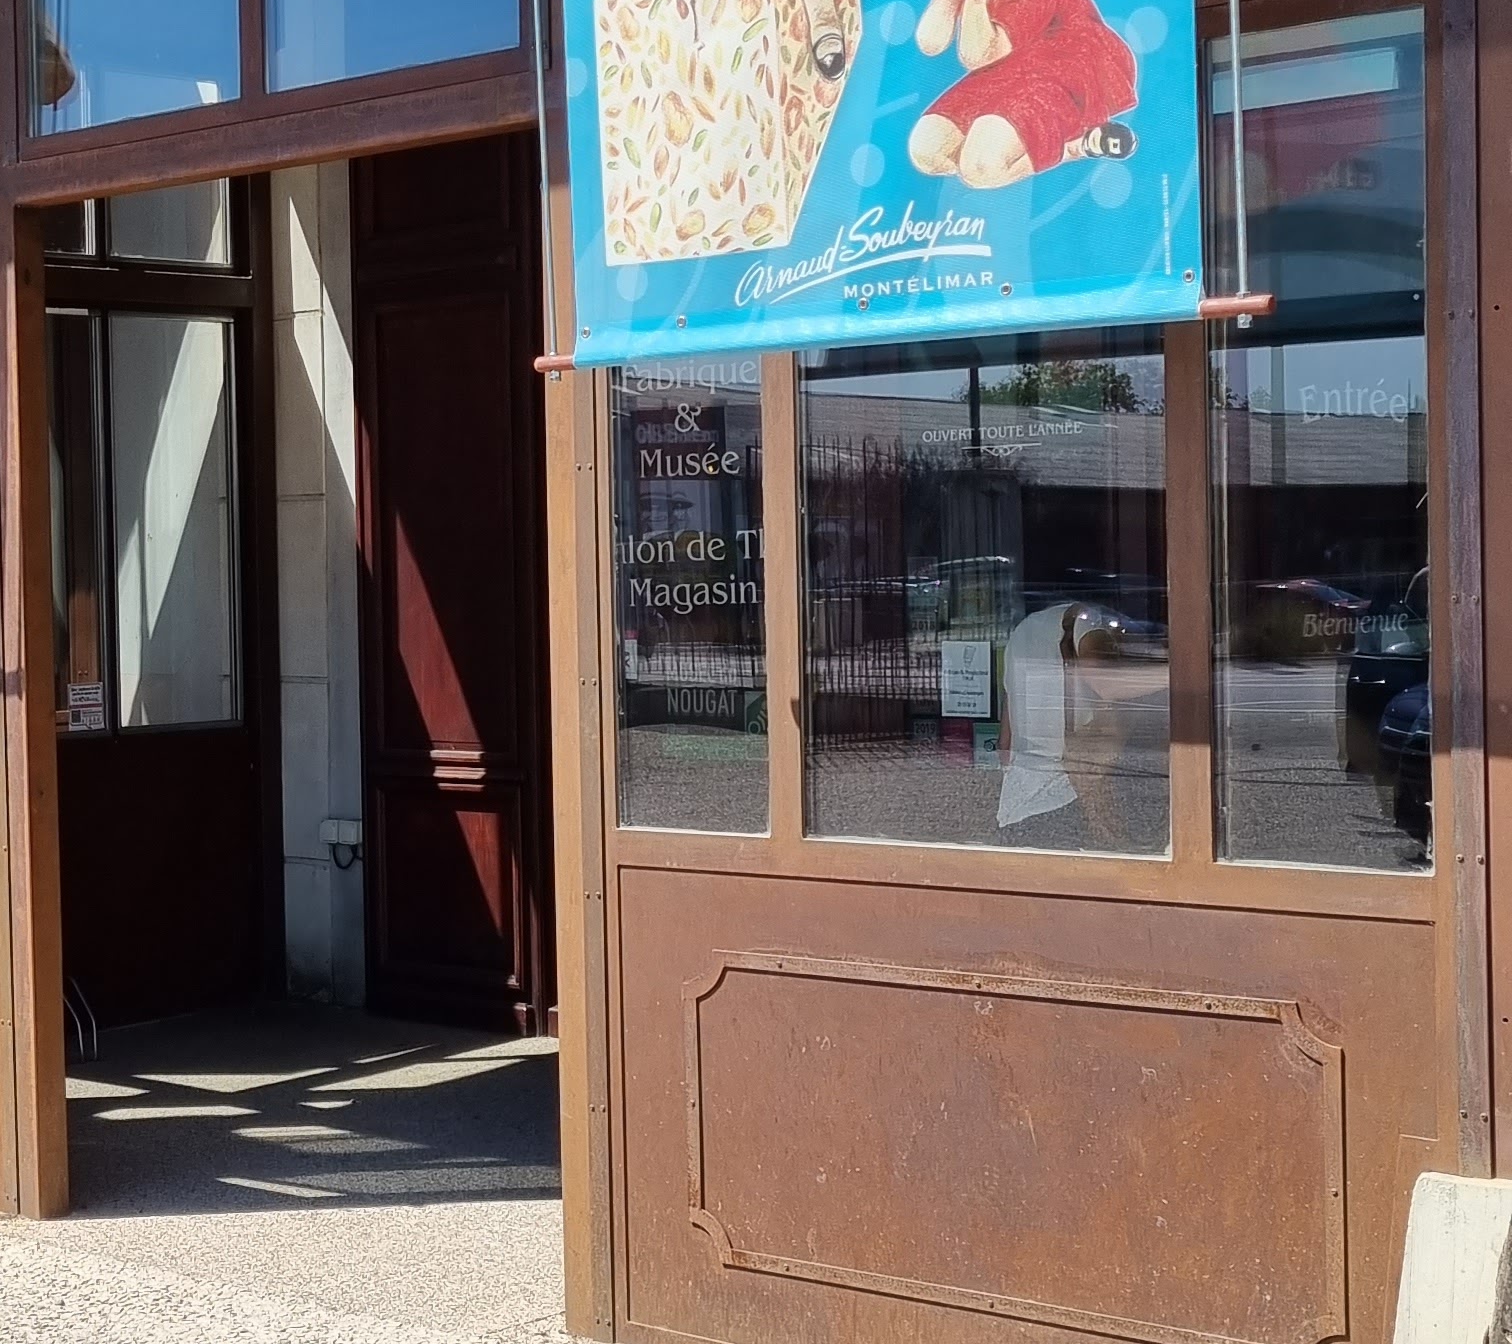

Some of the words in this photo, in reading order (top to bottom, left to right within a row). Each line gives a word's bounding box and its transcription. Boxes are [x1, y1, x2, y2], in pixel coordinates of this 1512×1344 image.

[843, 271, 994, 298] MONTÉLIMAR
[620, 358, 757, 396] Fabrique
[1298, 378, 1408, 424] Entrée
[674, 402, 702, 433] &
[922, 426, 975, 443] OUVERT
[979, 424, 1024, 440] TOUTE
[639, 443, 740, 478] Musée
[686, 530, 726, 562] de
[629, 573, 758, 614] Magasin
[1302, 613, 1409, 638] Bienvenue
[667, 689, 738, 717] NOUGAT
